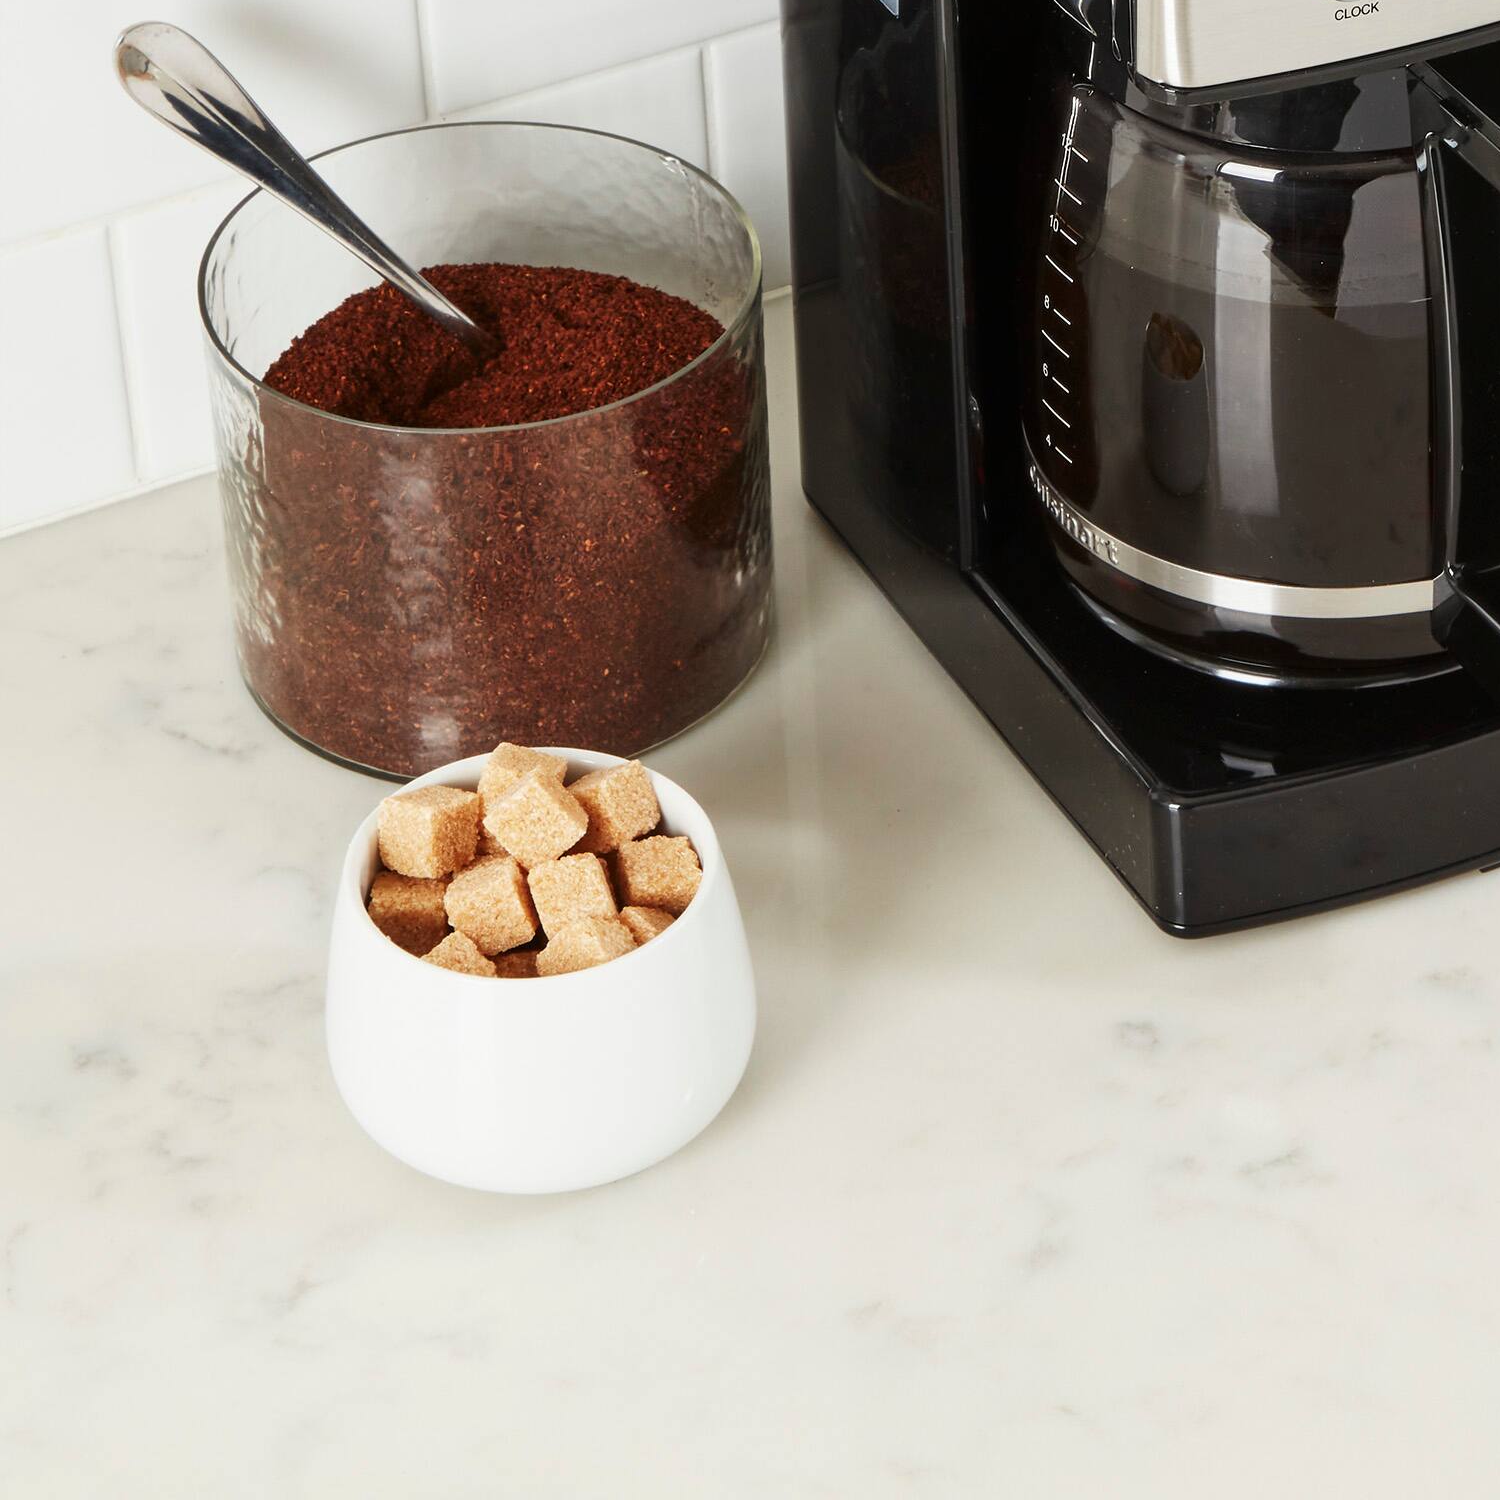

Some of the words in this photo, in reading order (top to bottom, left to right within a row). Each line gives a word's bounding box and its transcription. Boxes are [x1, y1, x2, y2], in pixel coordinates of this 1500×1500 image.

[1334, 1, 1380, 21] CLOCK
[1049, 214, 1059, 233] 10
[1043, 295, 1050, 309] 8
[1042, 363, 1049, 377] 6
[1045, 434, 1052, 447] 4
[1029, 465, 1119, 565] Cuisinart
